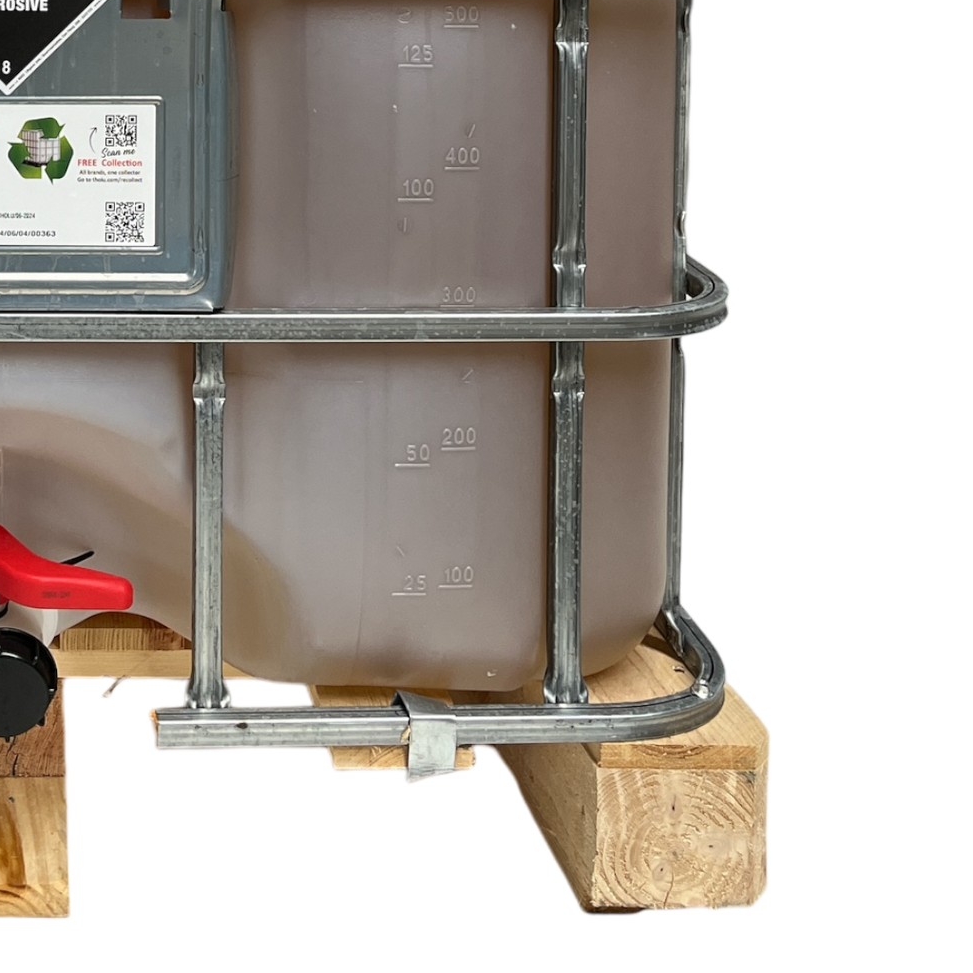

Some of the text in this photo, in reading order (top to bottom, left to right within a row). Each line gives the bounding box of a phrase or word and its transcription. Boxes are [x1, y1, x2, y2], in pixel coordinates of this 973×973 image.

[445, 6, 479, 21] 500
[403, 45, 433, 61] 125
[2, 60, 11, 75] 8
[101, 147, 120, 158] Scan
[445, 148, 480, 164] 400
[403, 179, 434, 196] 100
[443, 286, 476, 302] 300
[442, 428, 476, 445] 200
[407, 445, 430, 461] 50
[404, 575, 426, 590] 25
[445, 566, 473, 583] 100
